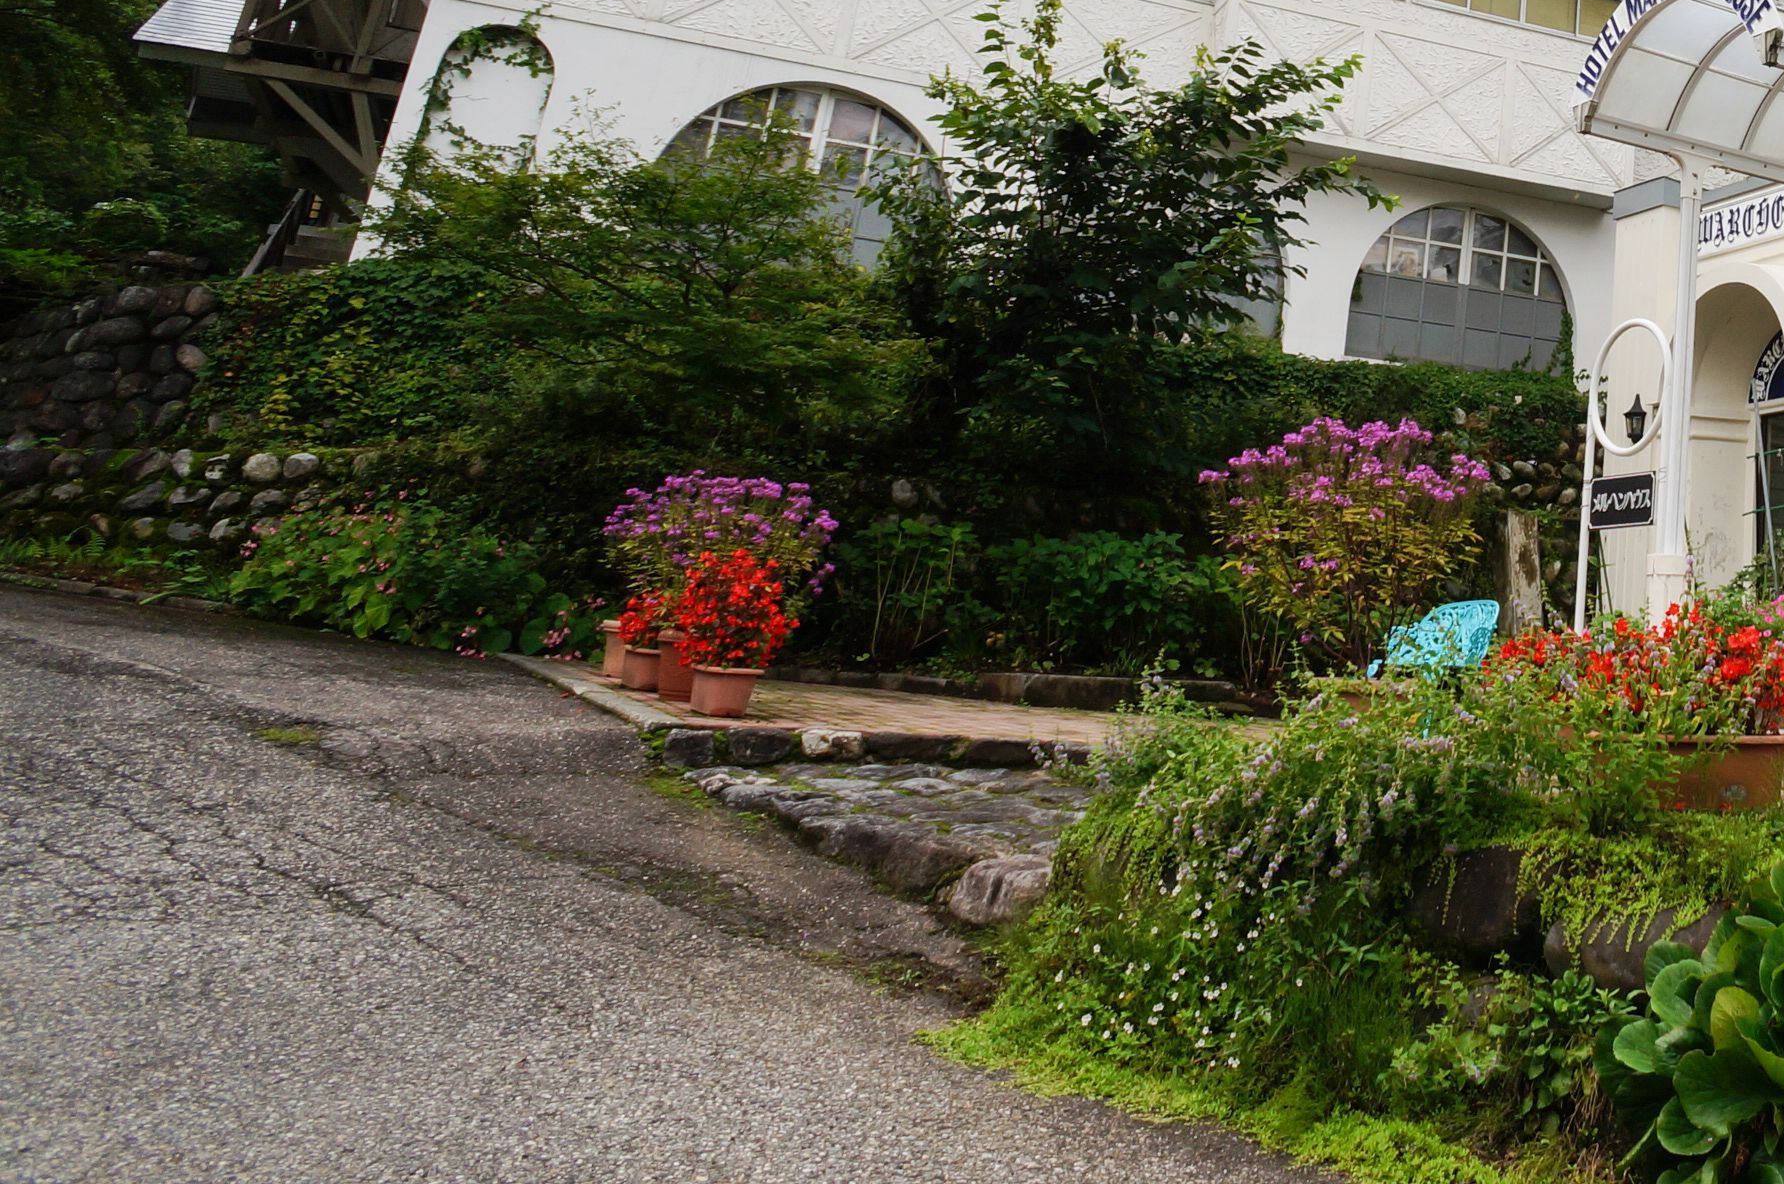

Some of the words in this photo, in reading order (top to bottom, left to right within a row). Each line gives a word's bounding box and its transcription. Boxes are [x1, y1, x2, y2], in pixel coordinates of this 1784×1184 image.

[1576, 17, 1626, 98] HOTEL
[1592, 489, 1650, 513] メルヘンハウス
